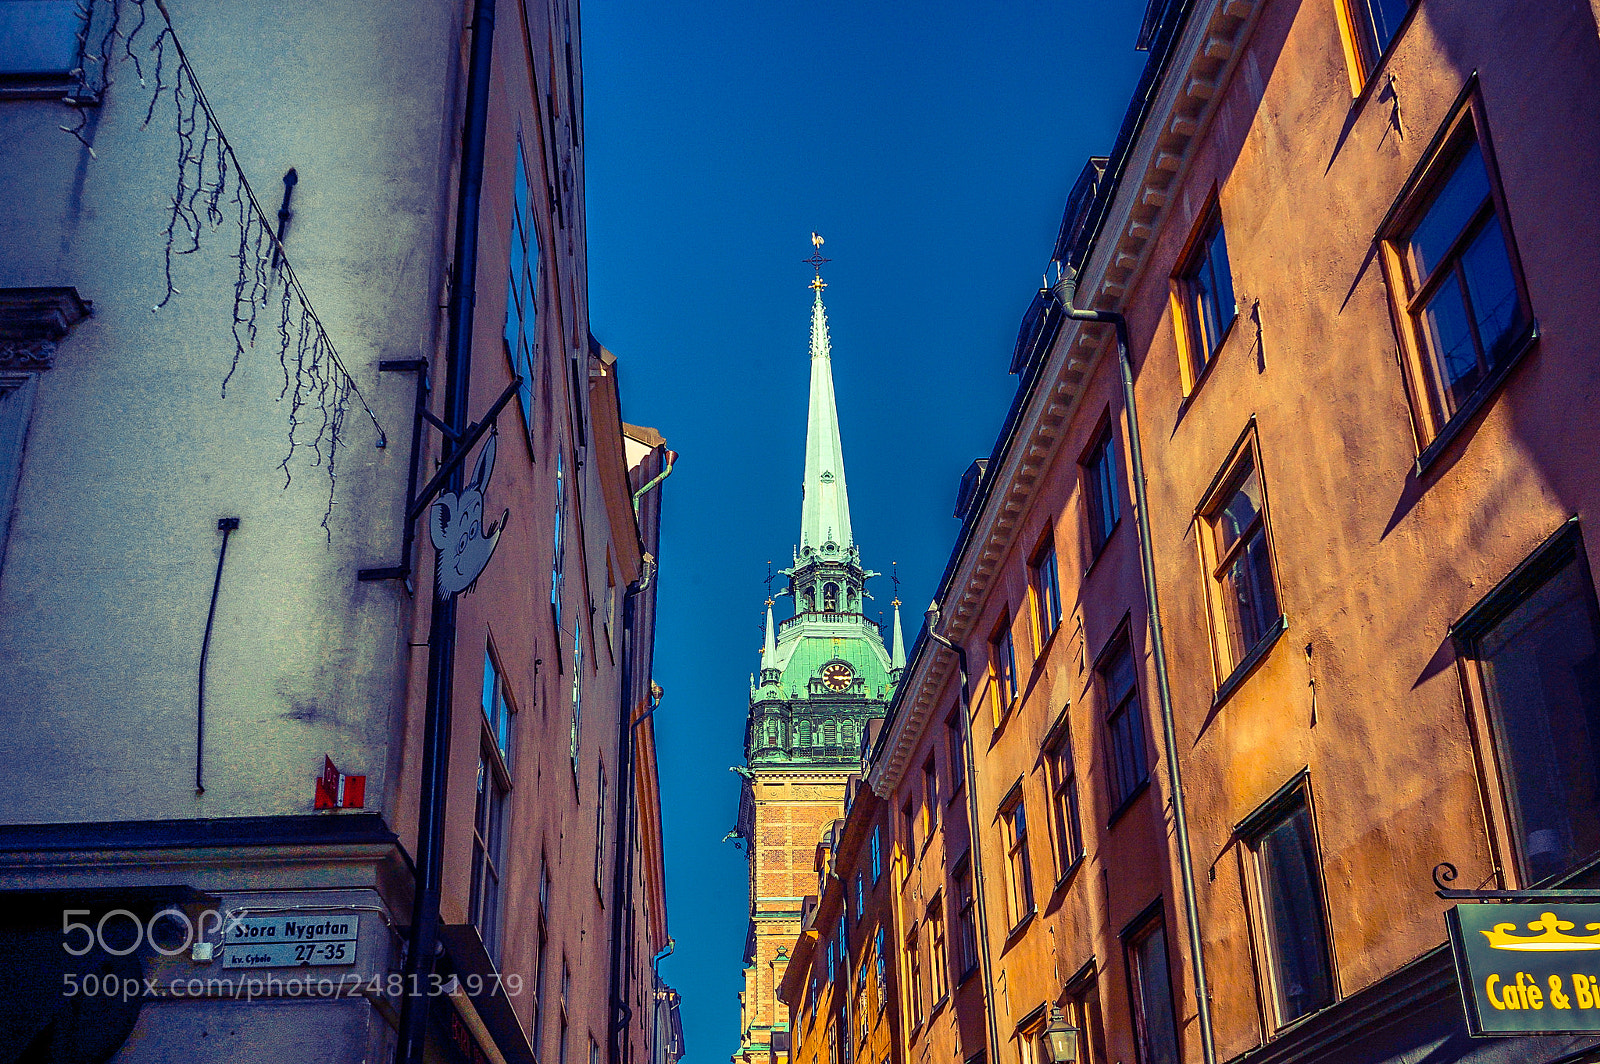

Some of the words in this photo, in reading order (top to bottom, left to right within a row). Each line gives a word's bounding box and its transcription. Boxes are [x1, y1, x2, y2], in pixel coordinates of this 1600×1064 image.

[235, 924, 276, 938] Stora
[284, 921, 349, 940] Nygatan
[294, 943, 346, 961] 27-35
[1486, 971, 1544, 1010] Cafè
[1548, 974, 1571, 1010] &
[1571, 973, 1600, 1010] Bi
